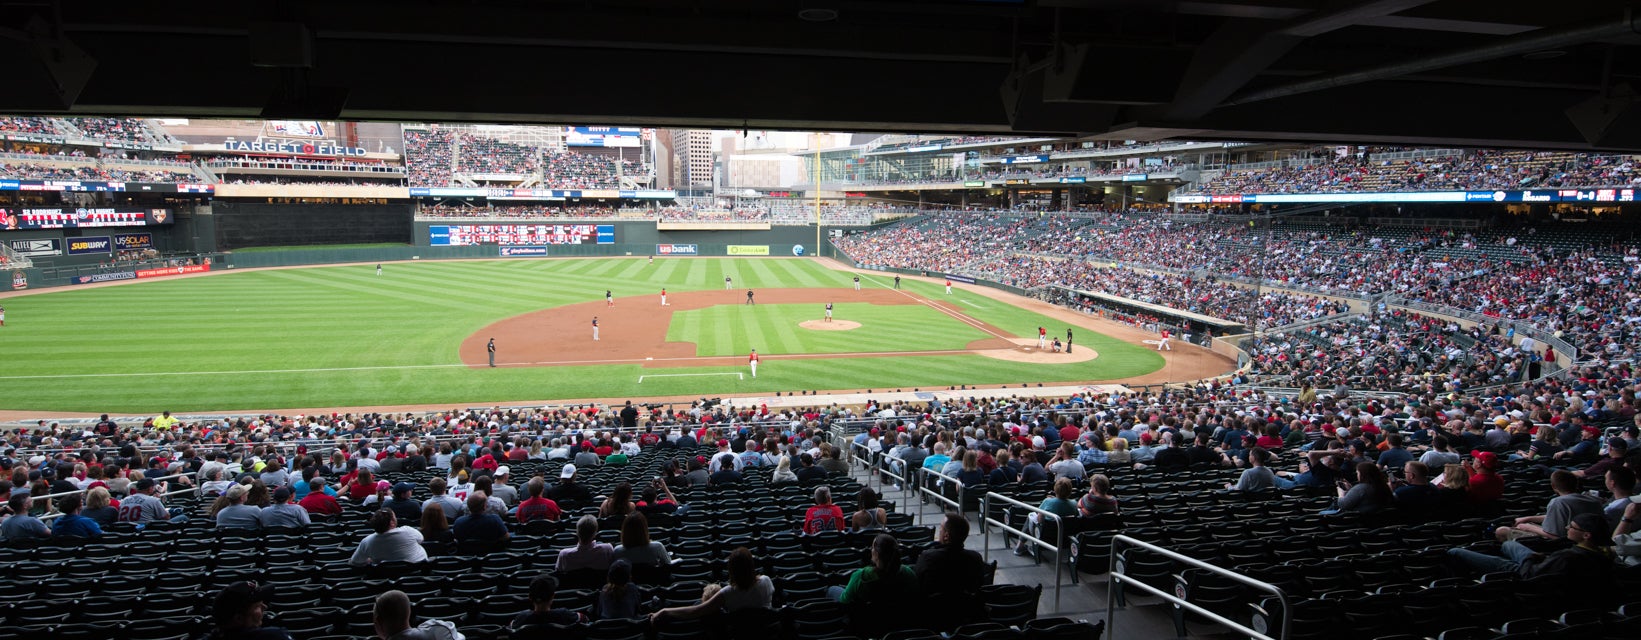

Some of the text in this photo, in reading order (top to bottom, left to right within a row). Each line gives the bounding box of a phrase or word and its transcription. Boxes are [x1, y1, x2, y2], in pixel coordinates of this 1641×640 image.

[224, 141, 367, 157] TARGET FIELD
[71, 241, 108, 250] SUBWAY
[455, 491, 467, 502] 7
[119, 505, 141, 521] 20
